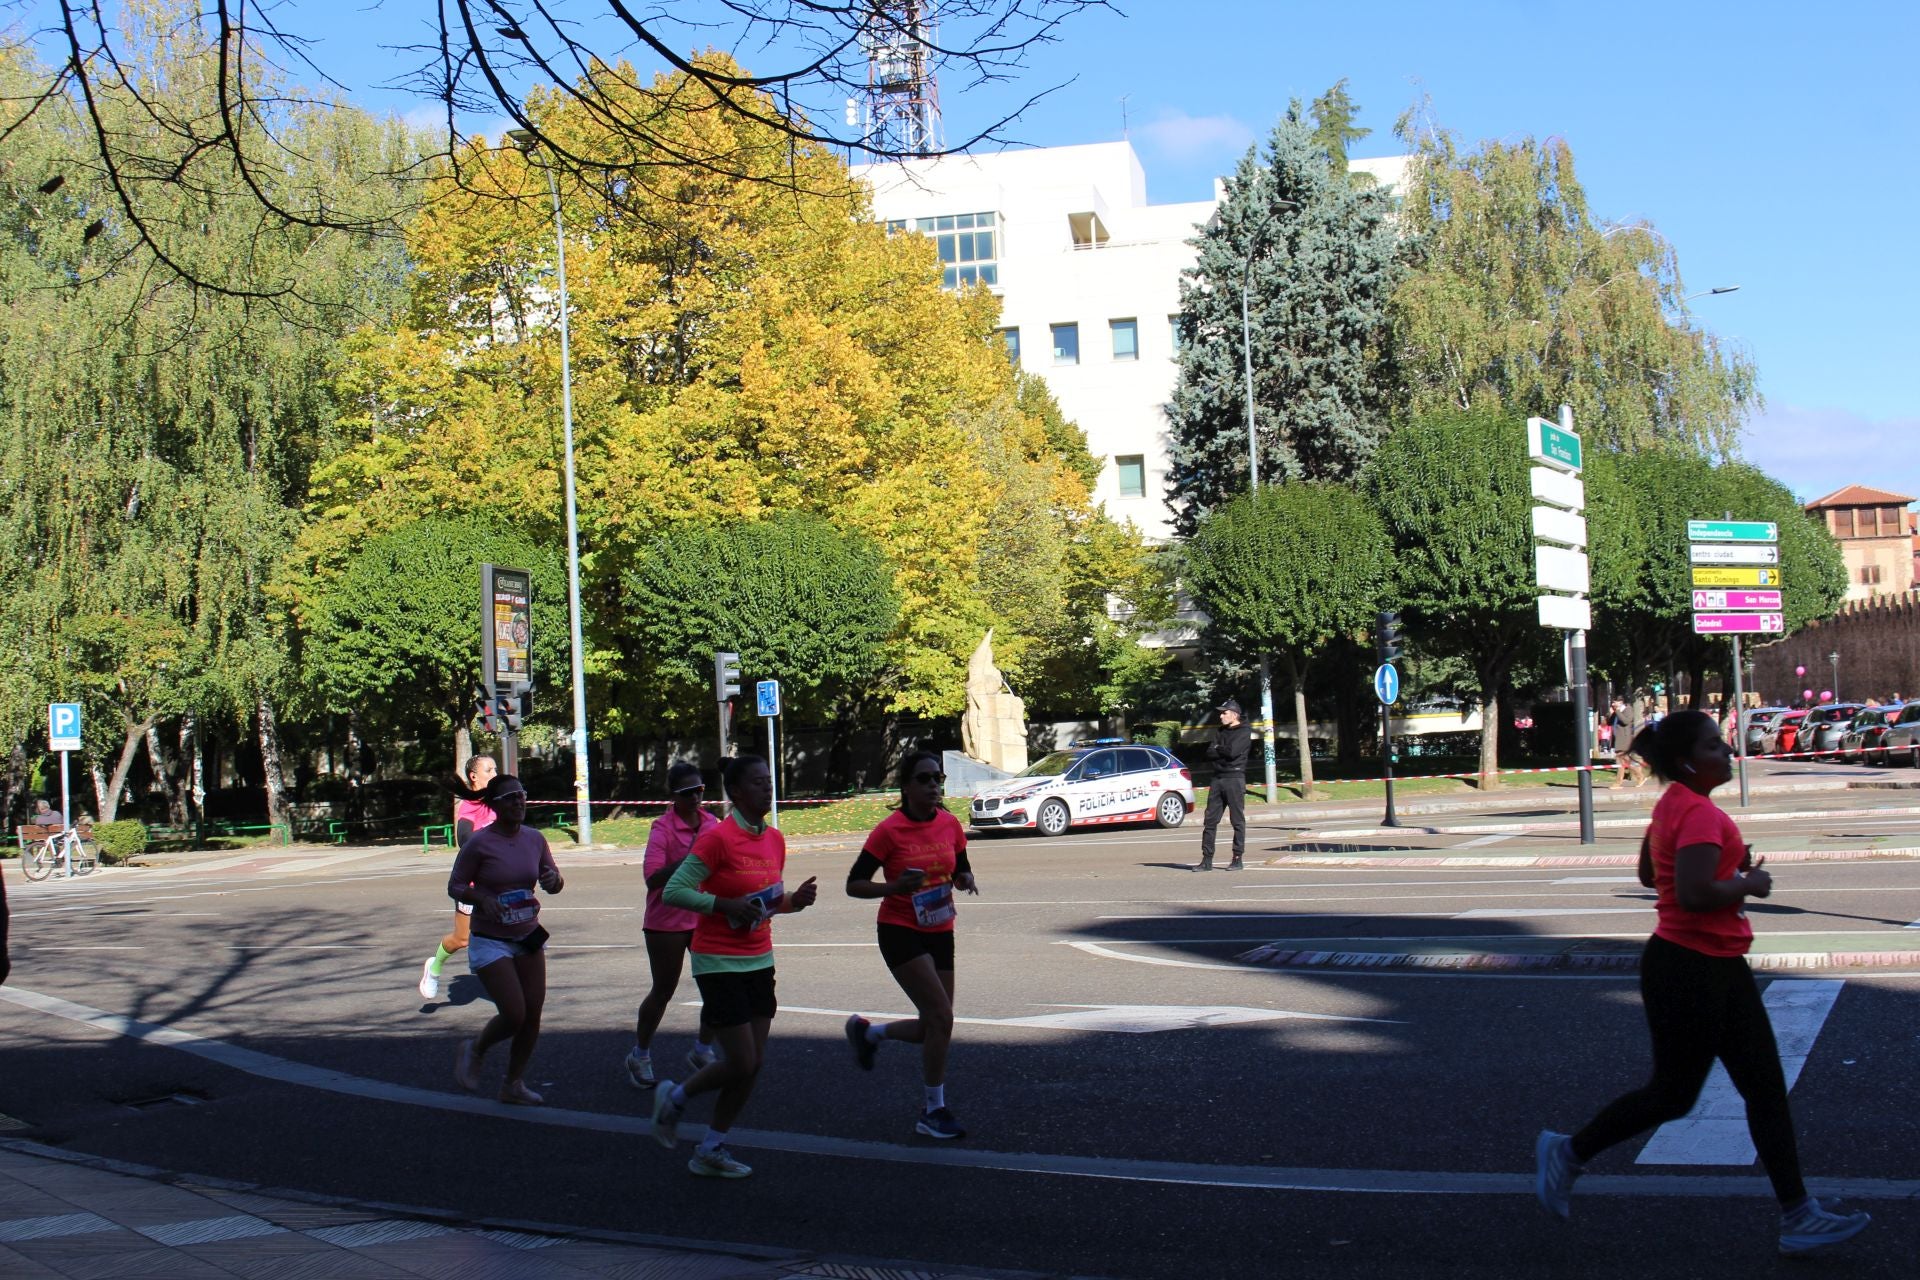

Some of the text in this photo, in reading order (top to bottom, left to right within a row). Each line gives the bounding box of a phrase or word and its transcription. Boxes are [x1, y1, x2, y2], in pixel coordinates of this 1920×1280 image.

[1690, 528, 1733, 537] Independencia
[1714, 576, 1739, 584] Domingo
[1745, 596, 1756, 604] San
[57, 708, 74, 735] P
[1120, 785, 1149, 803] LOCAL
